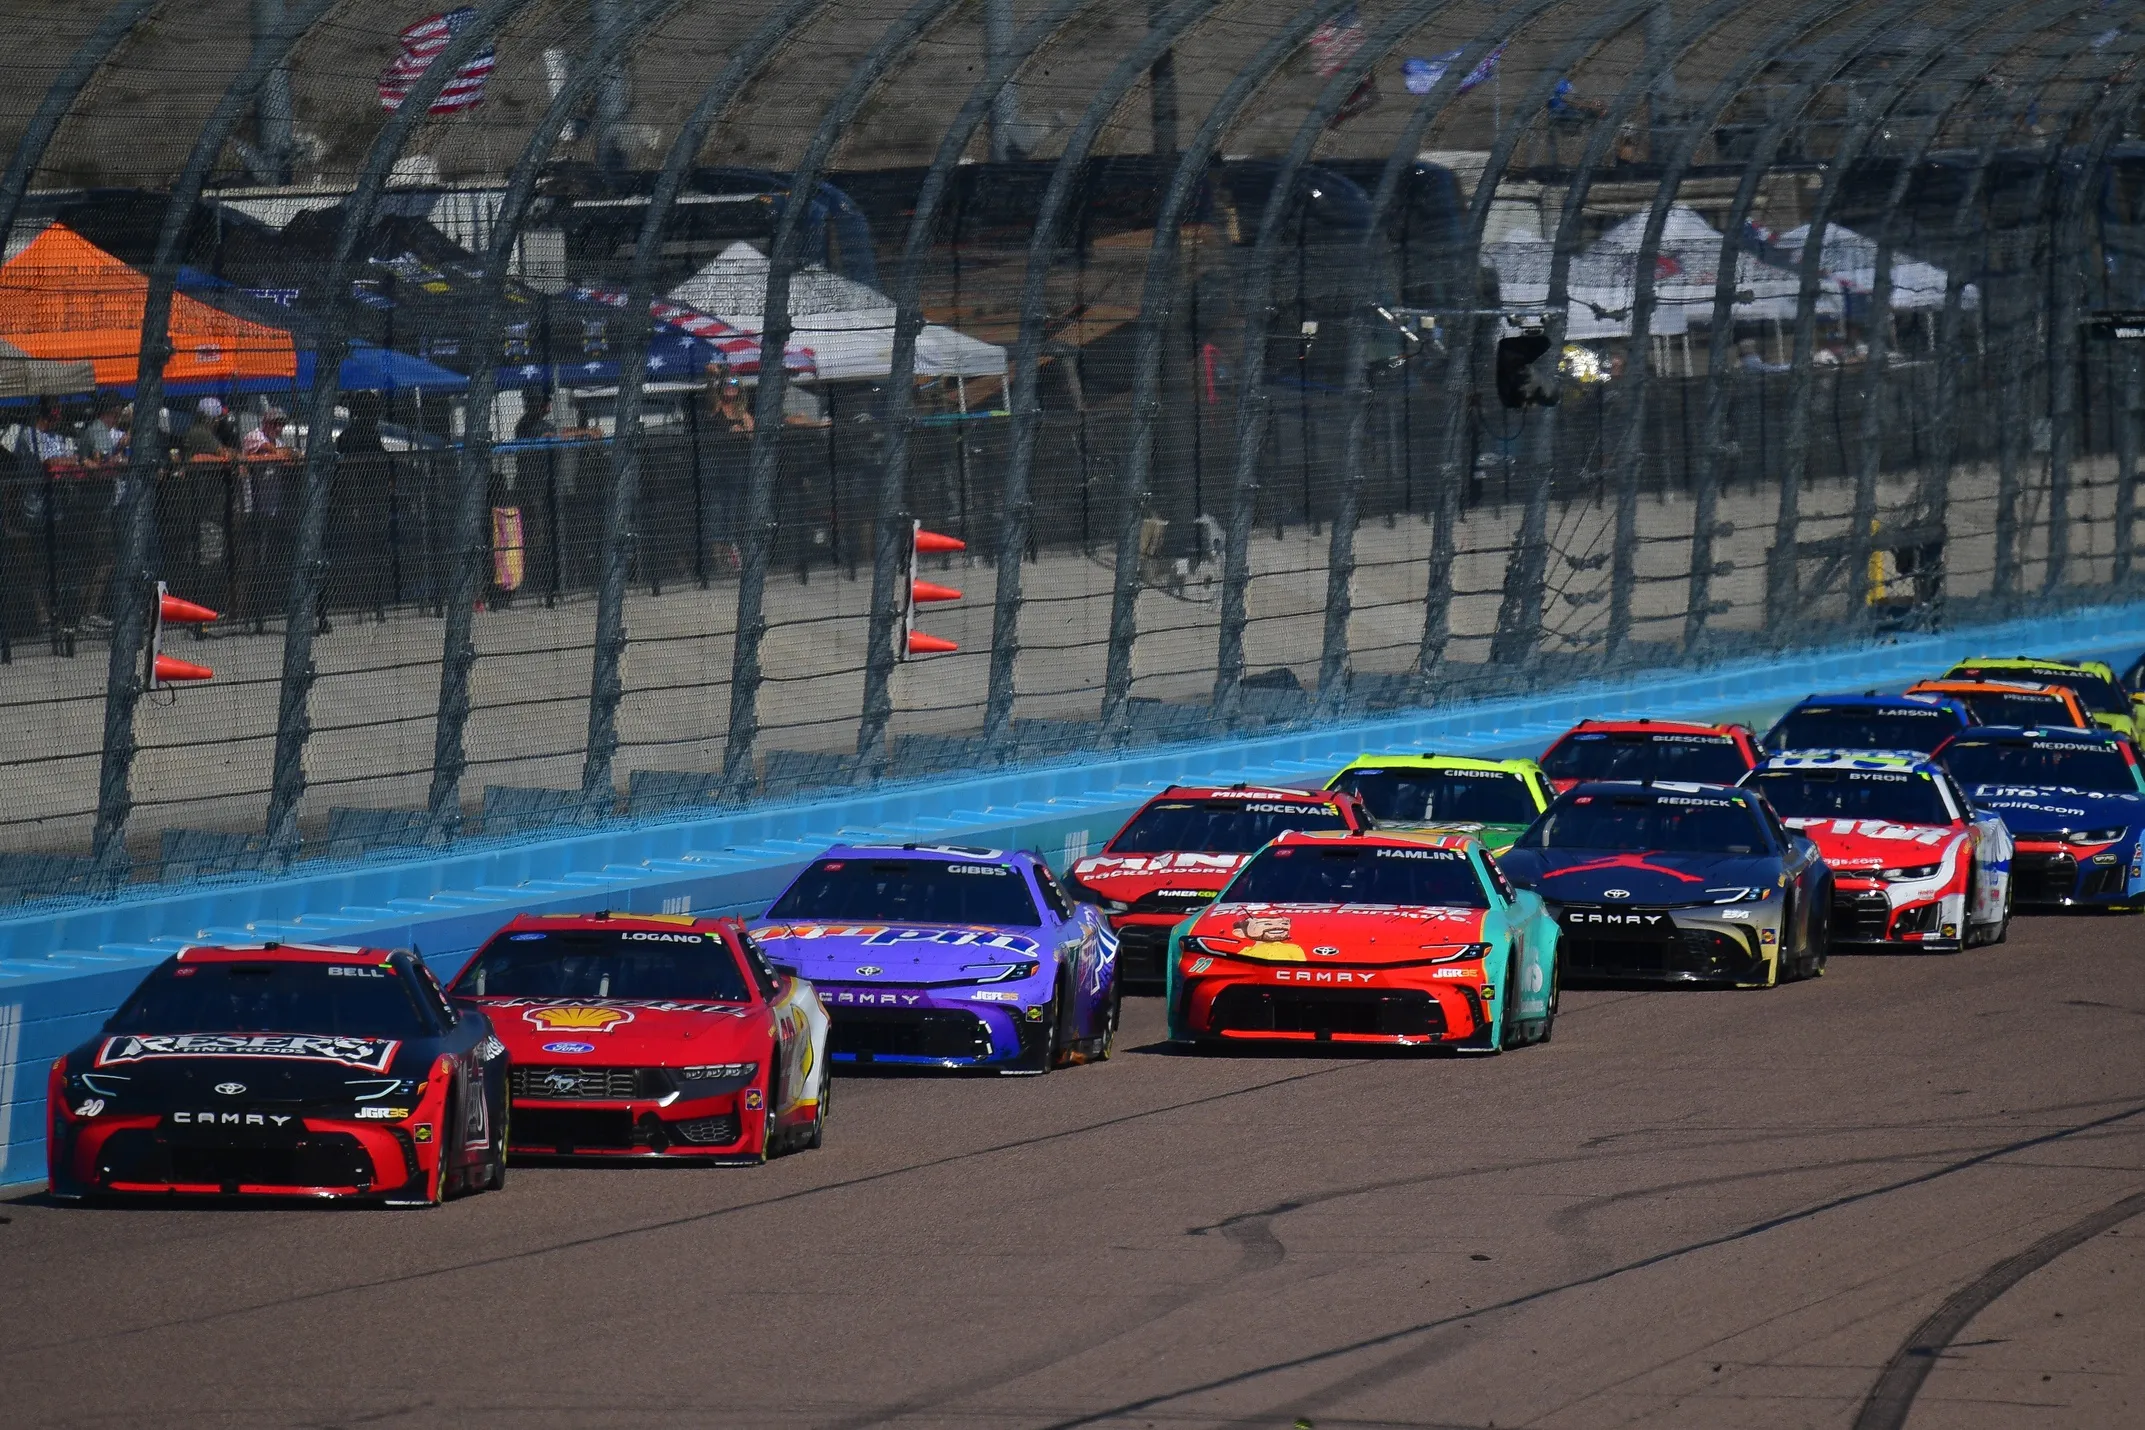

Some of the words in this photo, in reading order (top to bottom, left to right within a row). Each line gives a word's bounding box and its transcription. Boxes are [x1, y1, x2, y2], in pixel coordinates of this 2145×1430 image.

[2032, 667, 2094, 678] WALLACE
[1878, 708, 1938, 718] LARSON
[2033, 741, 2114, 754] MCDOWELL
[1444, 769, 1504, 779] CINDRIC
[1849, 772, 1908, 783] BYRON
[1211, 791, 1283, 800] MINER
[1657, 796, 1731, 808] REDDICK
[1245, 803, 1334, 816] HOCEVAR
[1988, 801, 2086, 817] relife.com
[1376, 849, 1455, 861] HAMLIN
[1075, 852, 1254, 874] MIN
[947, 864, 1007, 876] GIBBS
[1569, 913, 1663, 925] CAMRY
[621, 932, 702, 943] LOGANO
[1187, 957, 1214, 973] 11
[328, 966, 385, 978] BELL
[1276, 970, 1376, 983] CAMRY
[819, 992, 920, 1005] CAMRY
[74, 1099, 105, 1117] 20
[354, 1107, 409, 1119] JGR35
[173, 1111, 292, 1127] CAMRY
